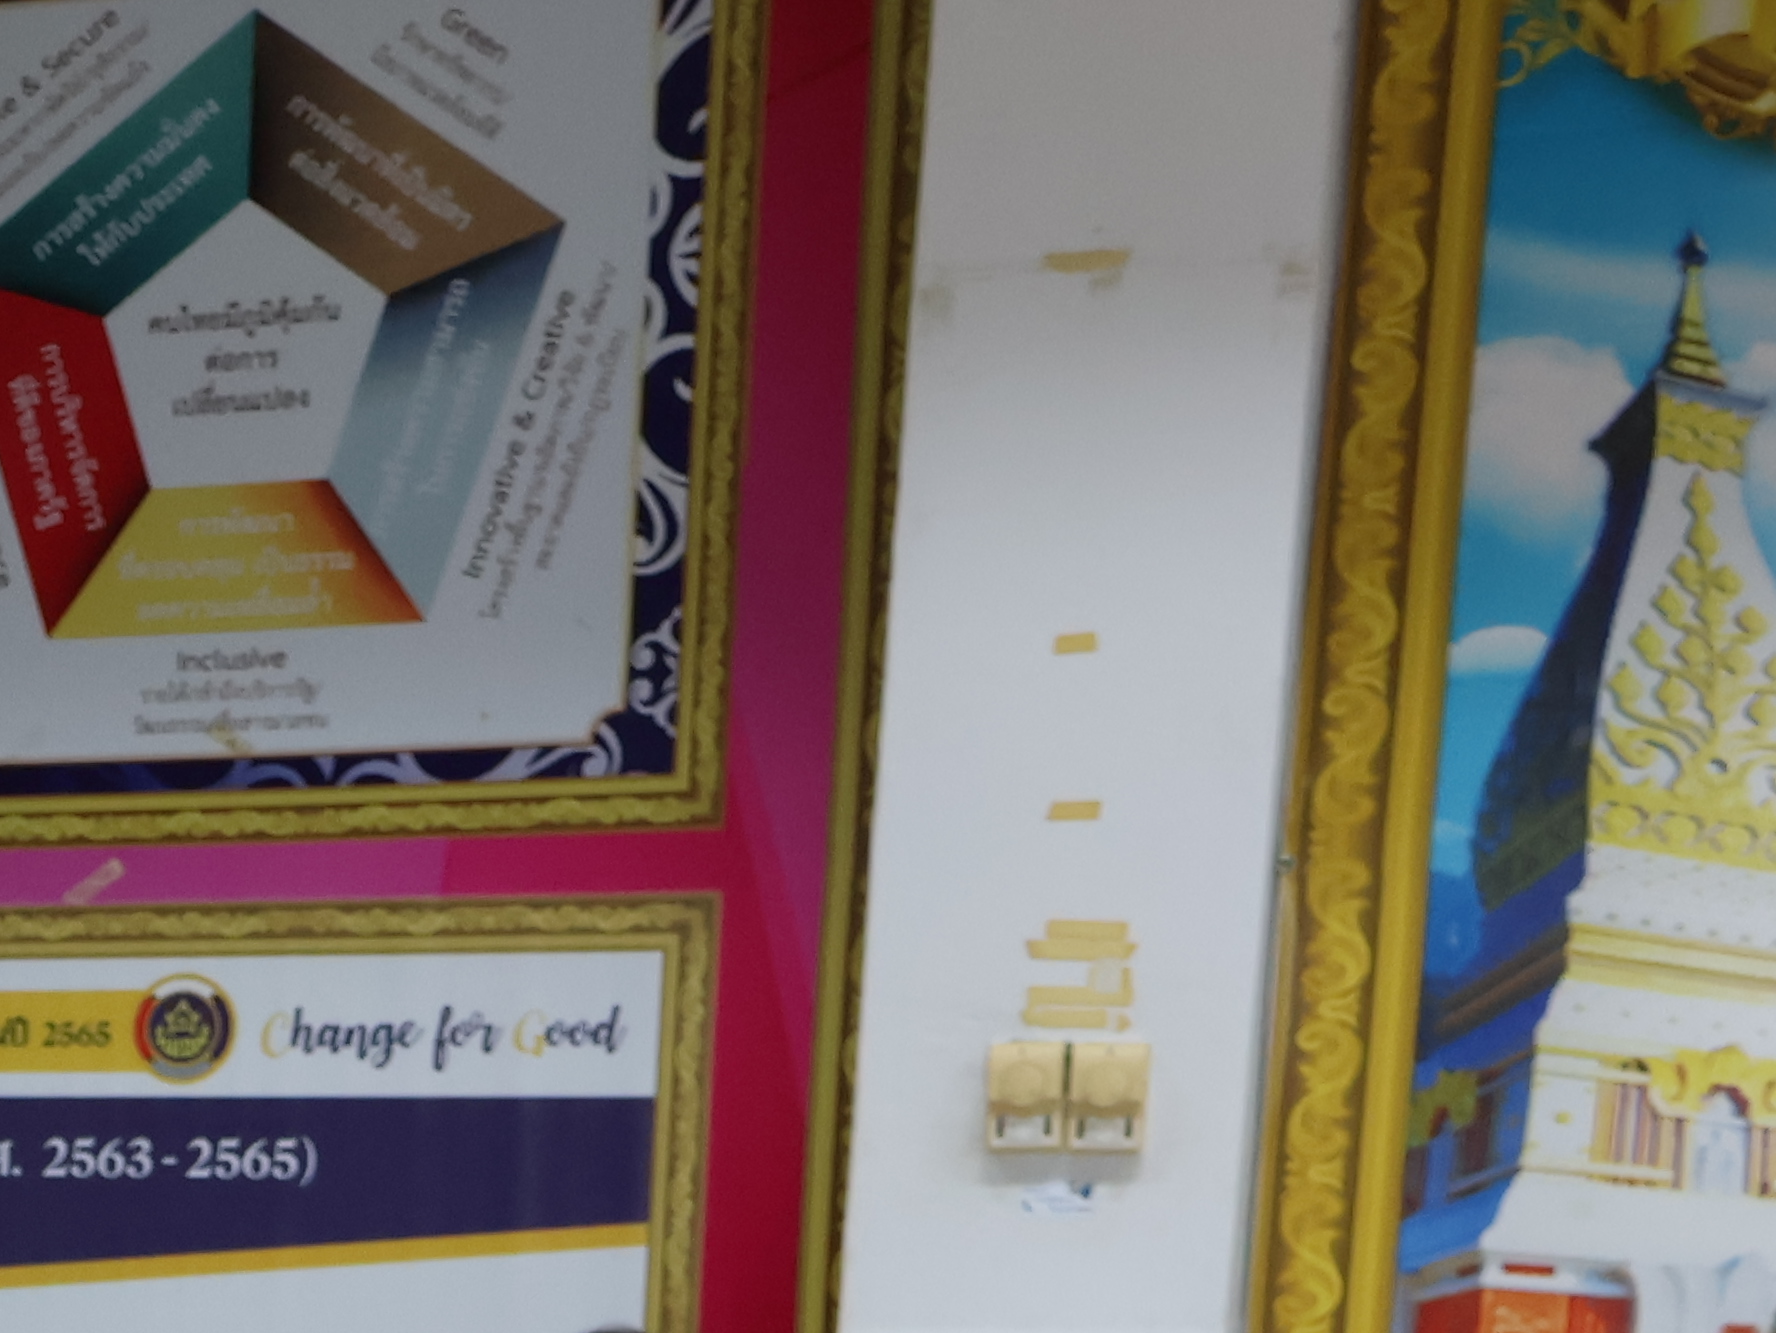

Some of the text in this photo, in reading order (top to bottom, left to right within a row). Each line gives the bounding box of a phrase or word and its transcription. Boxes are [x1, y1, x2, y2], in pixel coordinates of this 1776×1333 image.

[461, 437, 523, 583] Innovative
[523, 287, 578, 405] Creative
[176, 645, 291, 673] Inclusive
[42, 1020, 112, 1048] 2565
[260, 1004, 623, 1072] Change for Good
